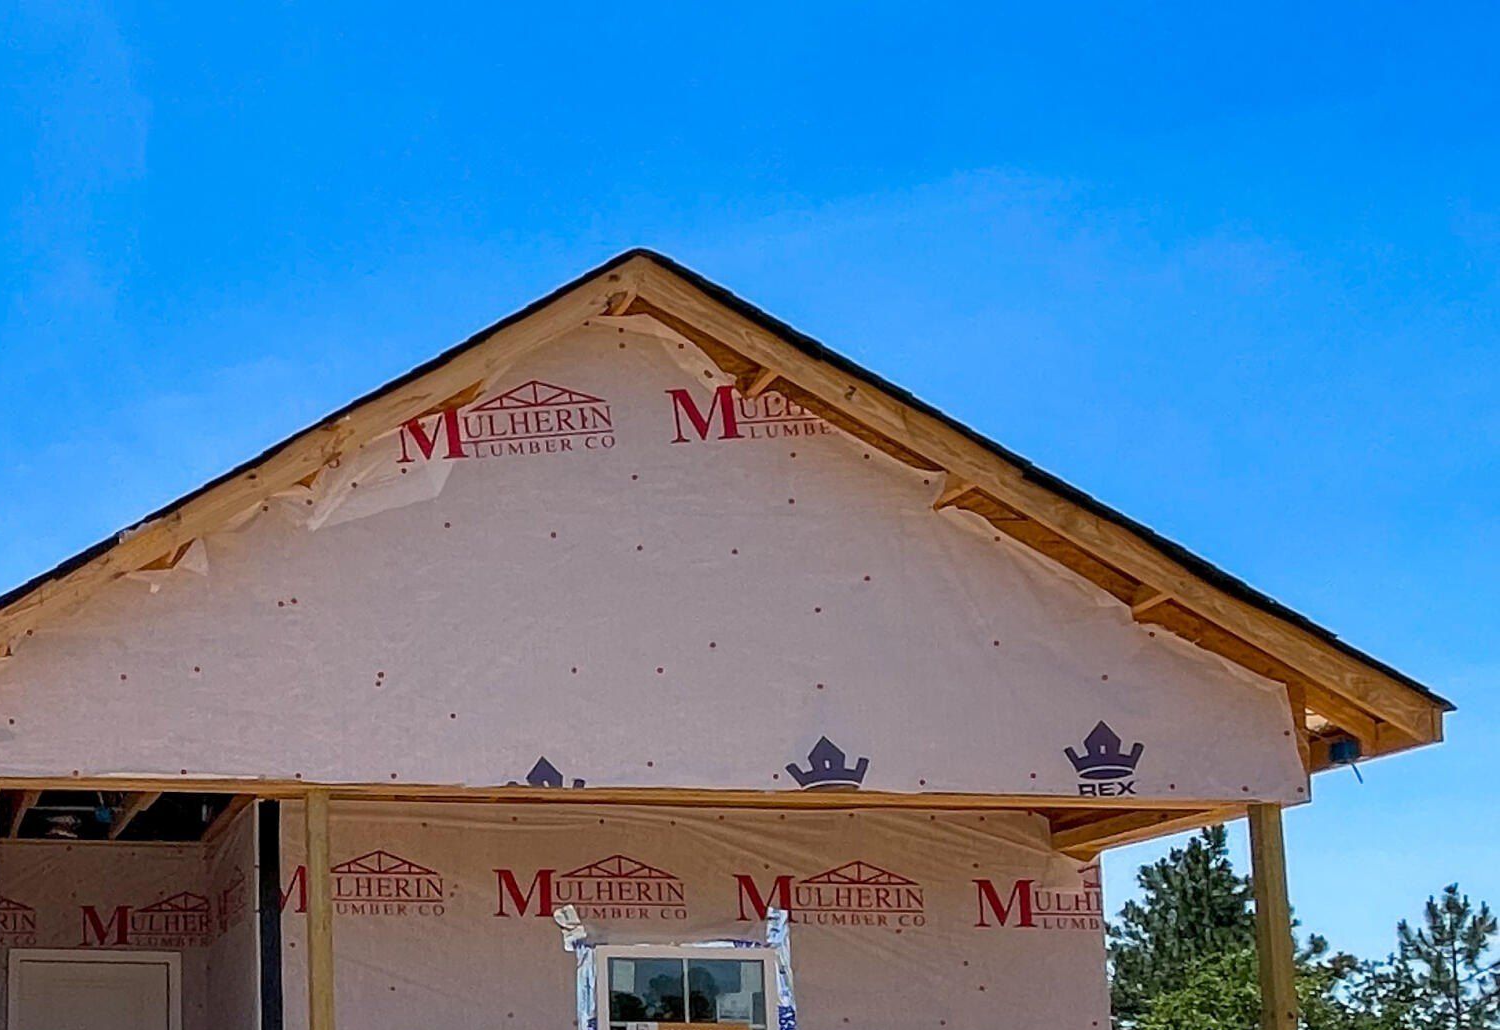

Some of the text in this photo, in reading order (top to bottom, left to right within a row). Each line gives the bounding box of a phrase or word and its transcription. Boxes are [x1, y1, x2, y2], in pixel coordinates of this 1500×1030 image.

[396, 404, 613, 463] MULHERIN
[750, 422, 832, 439] LUMBE
[474, 435, 616, 458] LUMBER CO
[1078, 781, 1136, 797] REX
[492, 868, 686, 918] MULHERIN
[736, 874, 925, 923] MULHERIN
[336, 902, 445, 916] UMBER CO
[577, 906, 688, 920] UMBER CO
[803, 912, 926, 928] LUMBER CO
[1043, 918, 1100, 930] LUMB
